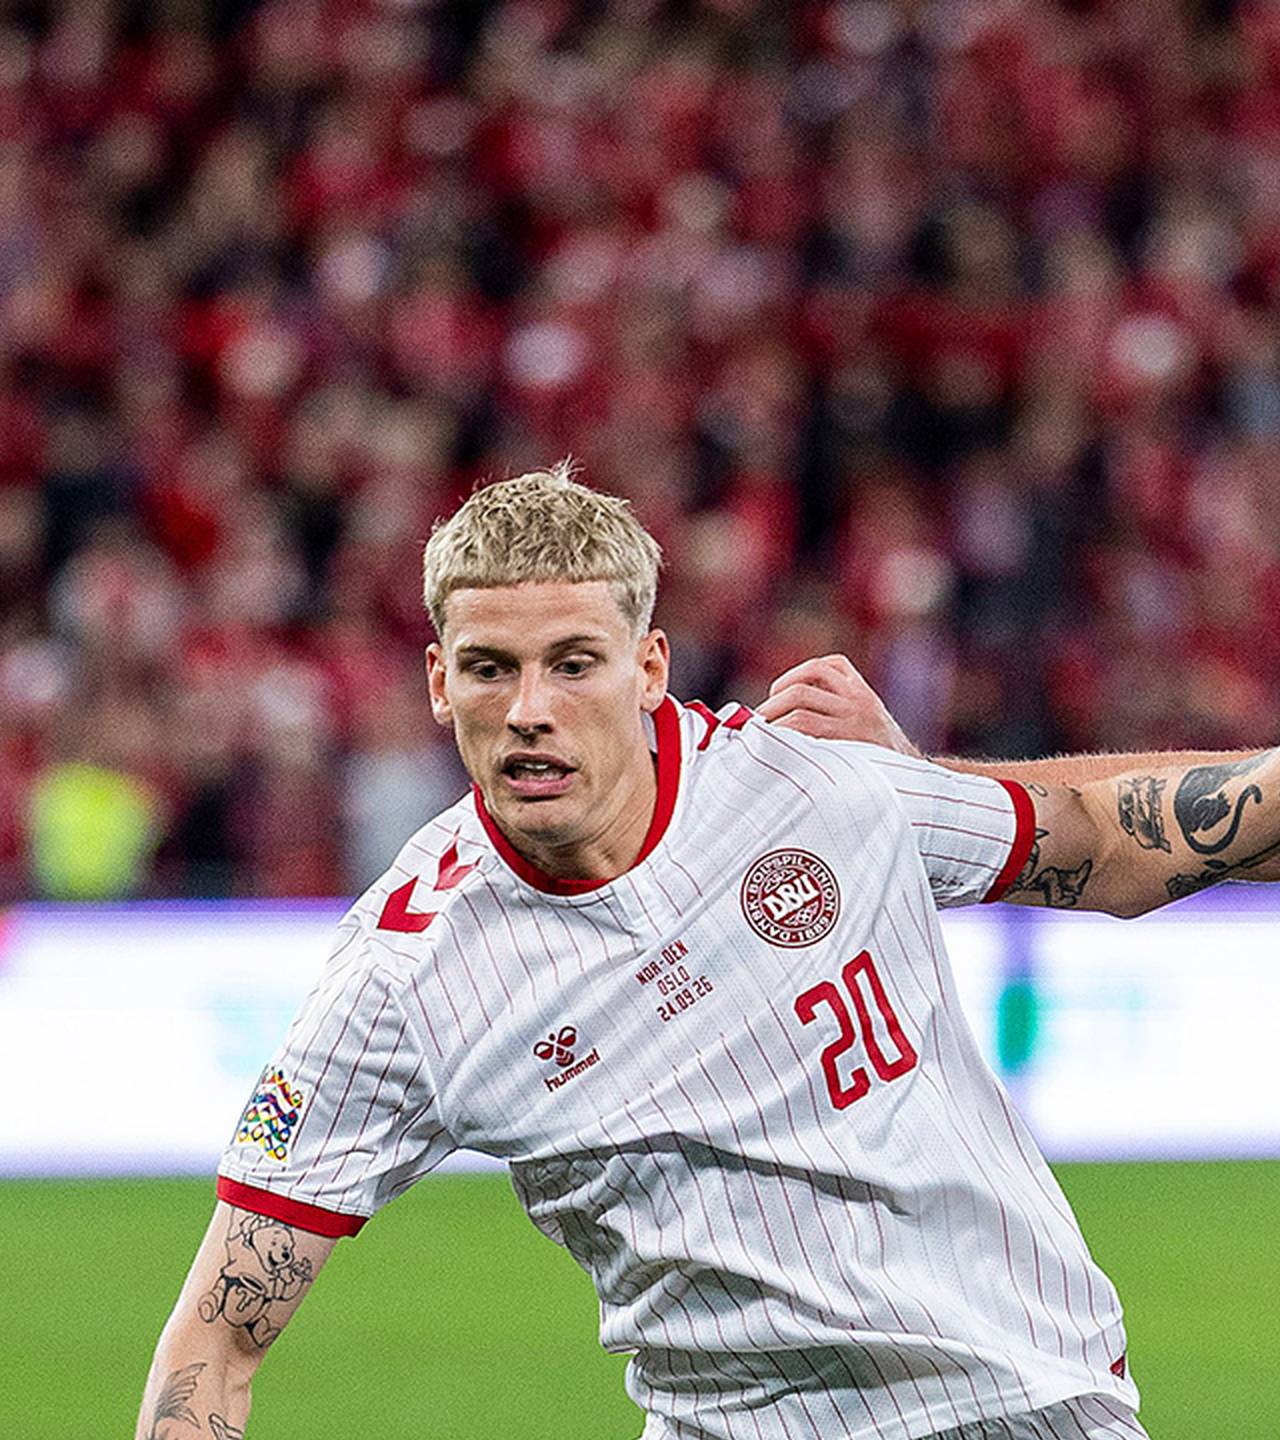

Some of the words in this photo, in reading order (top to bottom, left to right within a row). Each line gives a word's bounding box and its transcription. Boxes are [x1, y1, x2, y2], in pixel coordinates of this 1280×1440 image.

[761, 873, 821, 922] DBU
[656, 965, 691, 996] OSLO
[656, 975, 714, 1022] 24.09.26
[794, 949, 918, 1111] 20
[543, 1047, 601, 1093] hummel
